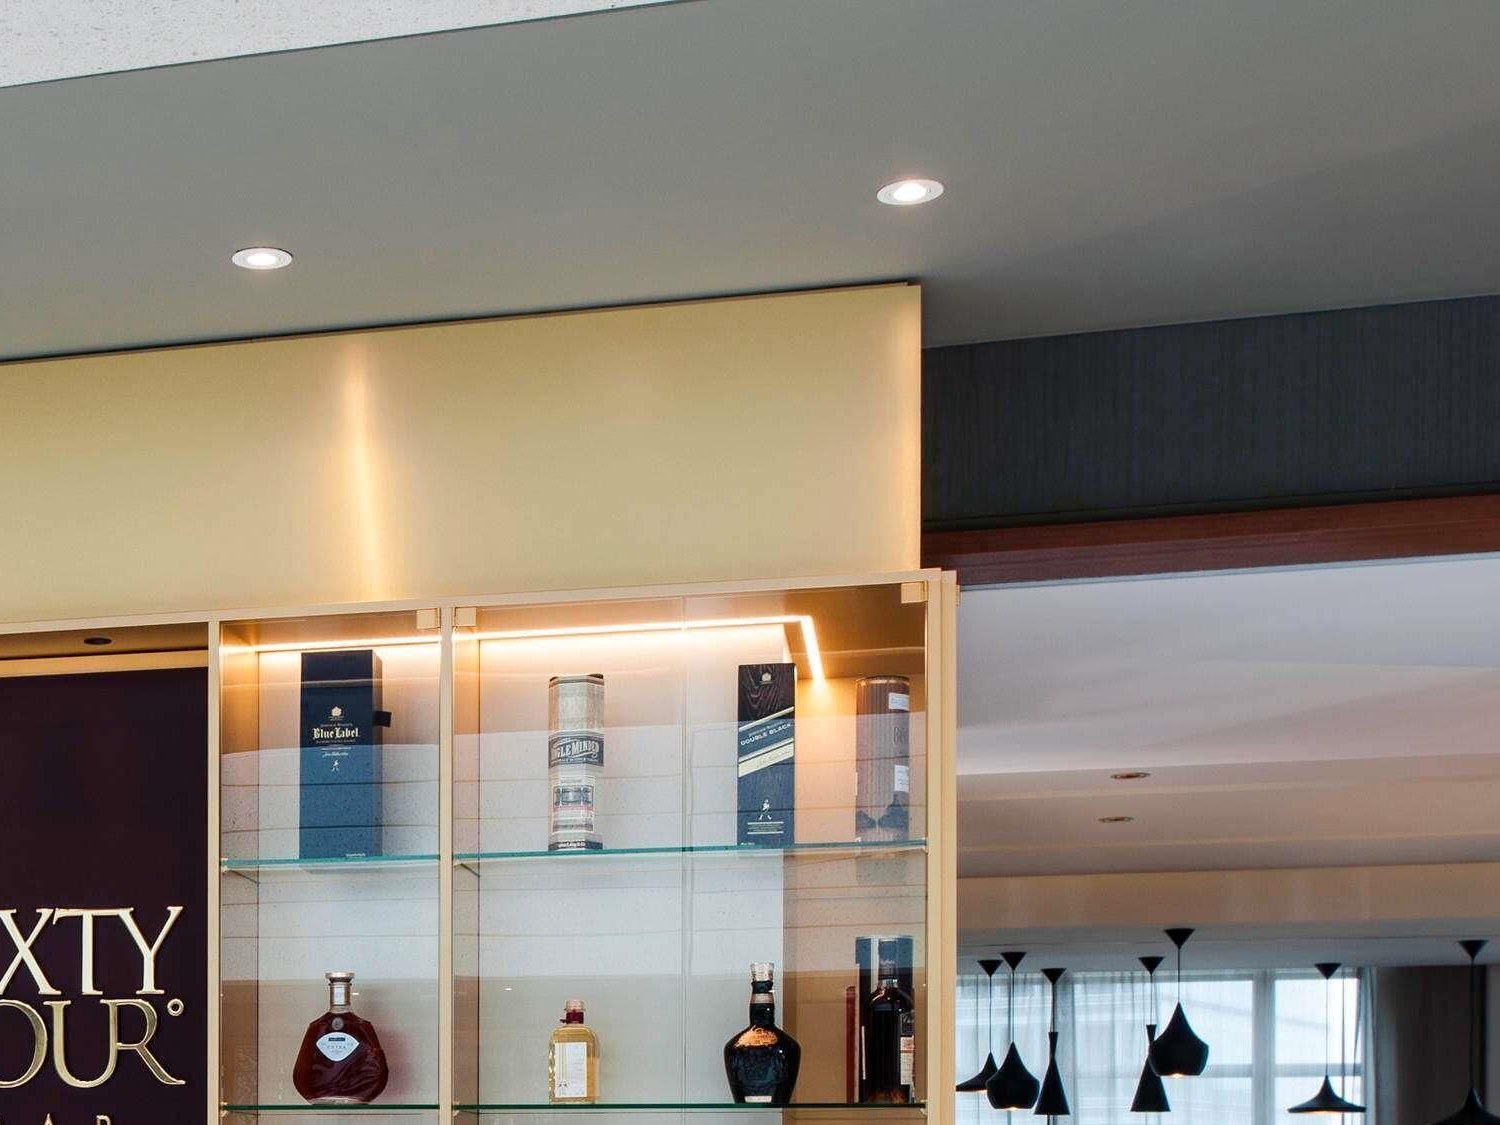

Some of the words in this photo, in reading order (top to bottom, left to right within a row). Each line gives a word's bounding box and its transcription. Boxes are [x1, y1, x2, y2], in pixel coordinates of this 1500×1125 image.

[312, 727, 334, 740] Blue
[335, 727, 359, 738] Label
[740, 731, 768, 746] DOUBLE
[769, 722, 791, 735] BLACK
